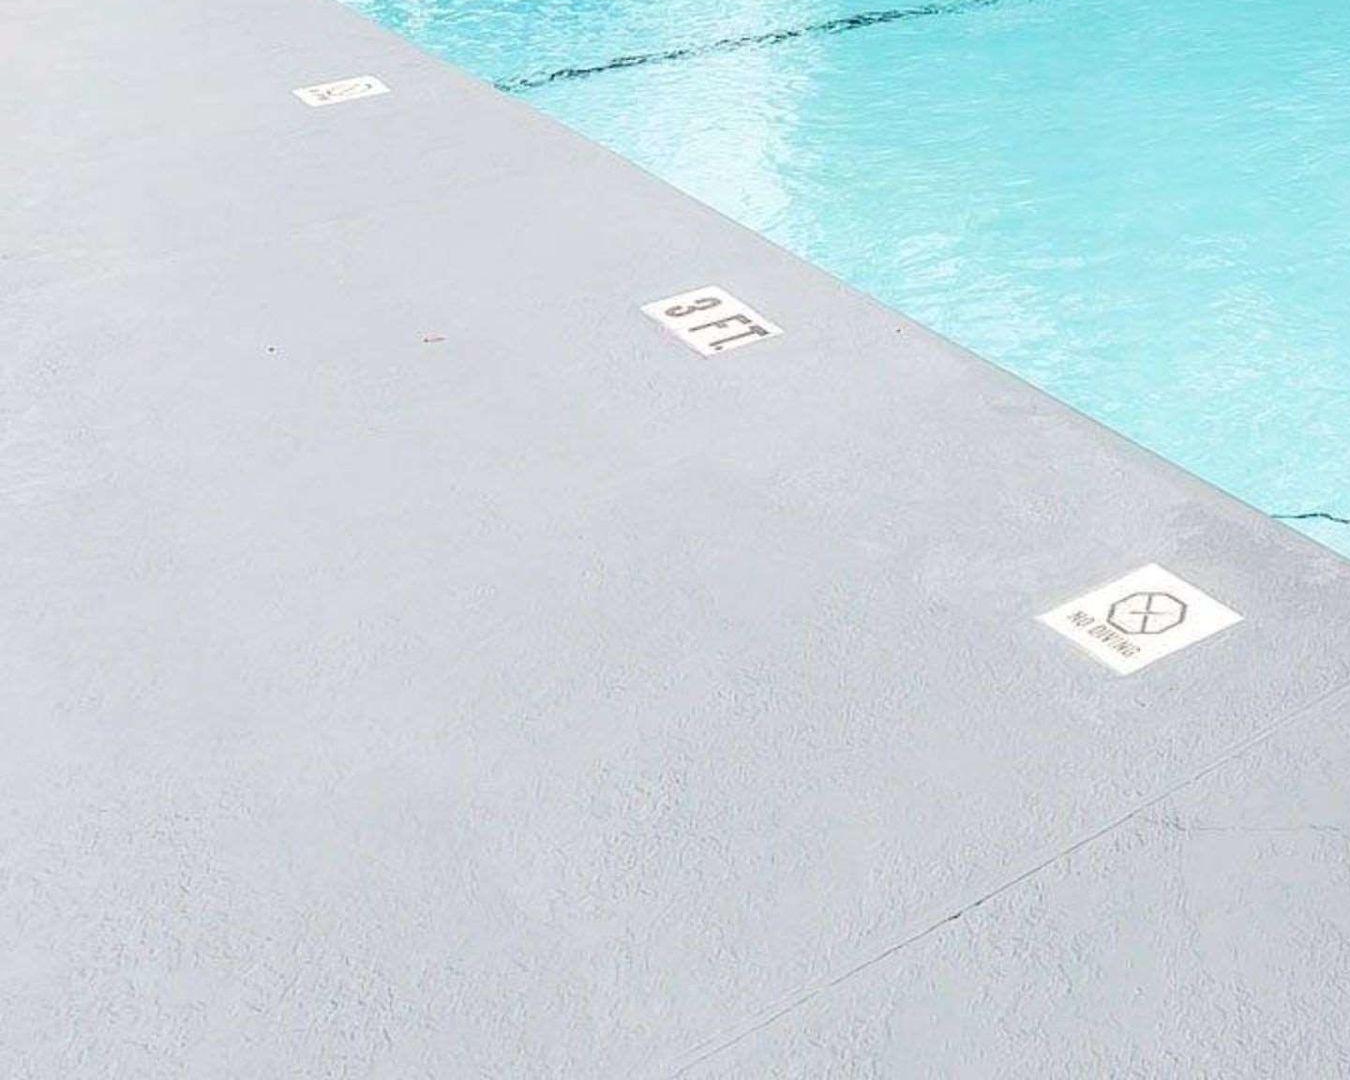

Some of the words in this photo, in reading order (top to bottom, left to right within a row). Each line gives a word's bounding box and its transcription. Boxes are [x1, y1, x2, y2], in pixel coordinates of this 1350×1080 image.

[665, 297, 722, 317] 3
[688, 314, 769, 351] FT.
[1067, 611, 1095, 627] NO
[1089, 624, 1141, 658] DIVING
